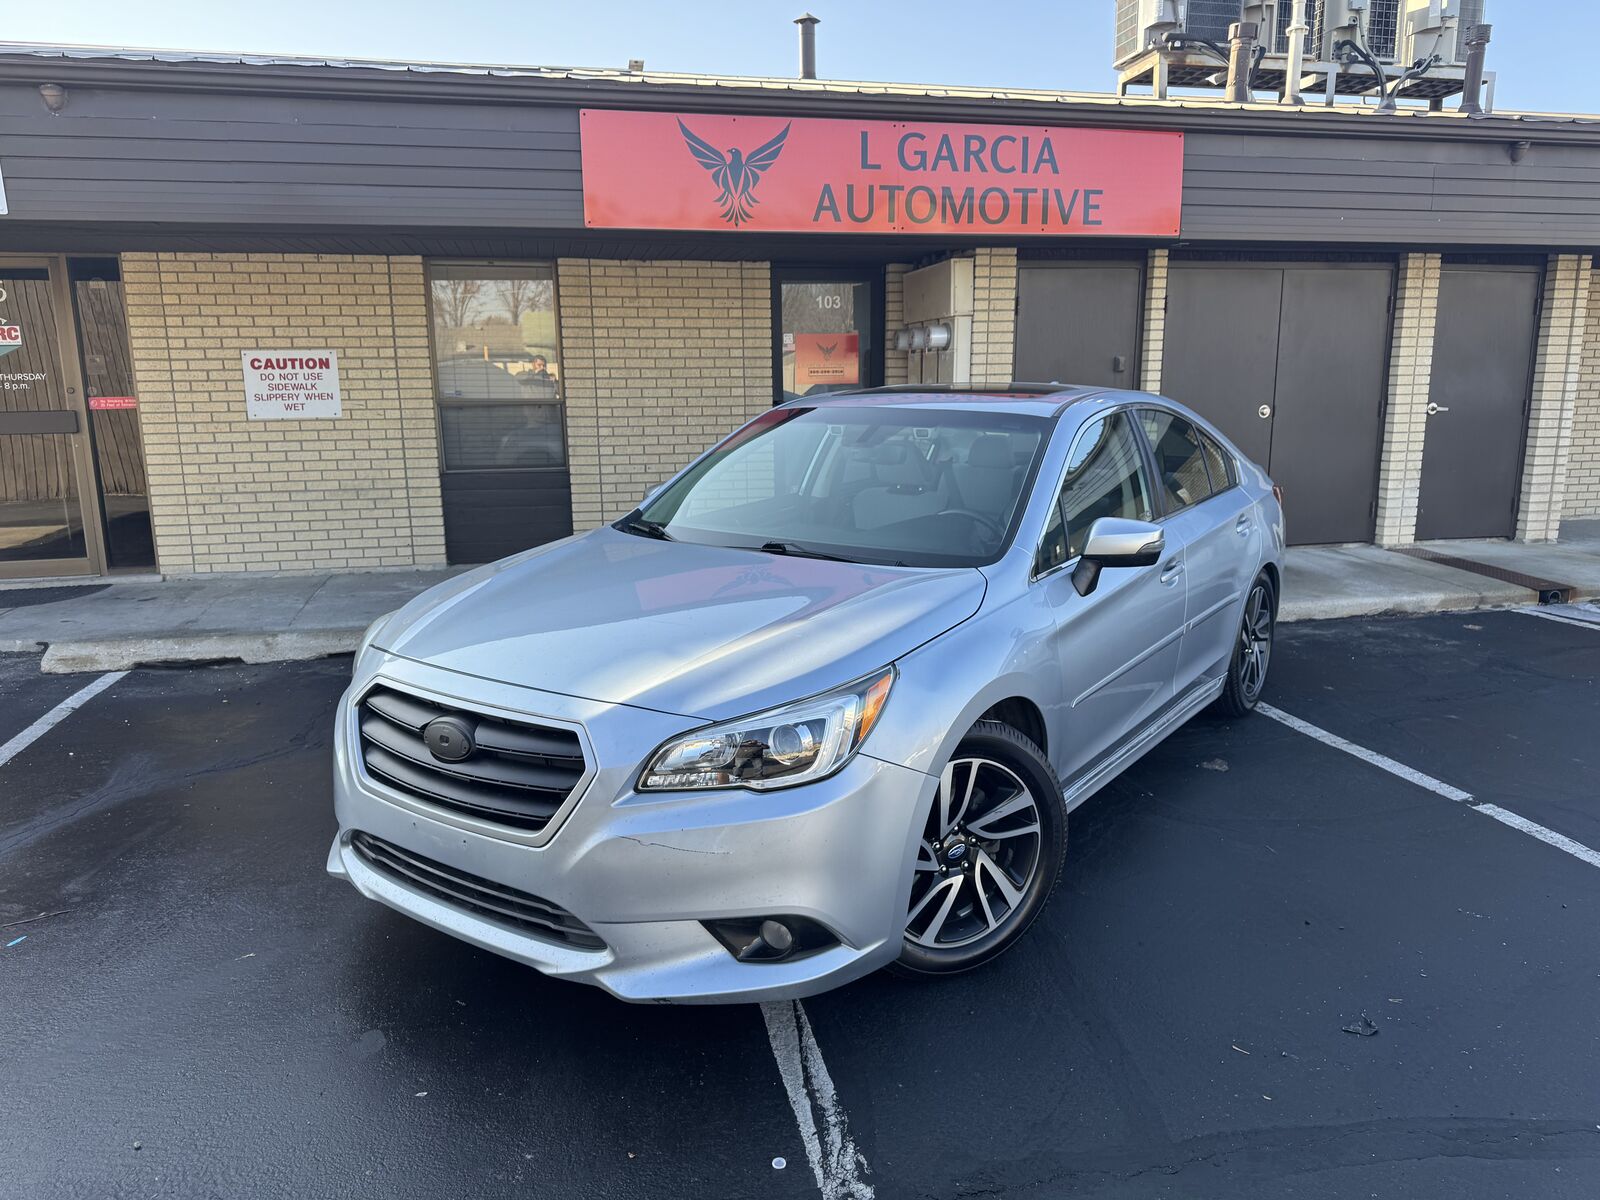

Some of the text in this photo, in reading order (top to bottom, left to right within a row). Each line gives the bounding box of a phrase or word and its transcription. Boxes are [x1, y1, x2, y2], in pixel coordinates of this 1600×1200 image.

[860, 131, 1060, 175] L GARCIA
[812, 183, 1104, 227] AUTOMOTIVE
[816, 295, 841, 309] 103
[250, 357, 330, 370] CAUTION
[260, 372, 323, 381] DO NOT USE
[4, 382, 11, 390] 8
[267, 383, 318, 391] SIDEWALK
[254, 392, 334, 402] SLIPPERY WHEN
[284, 403, 305, 411] WET
